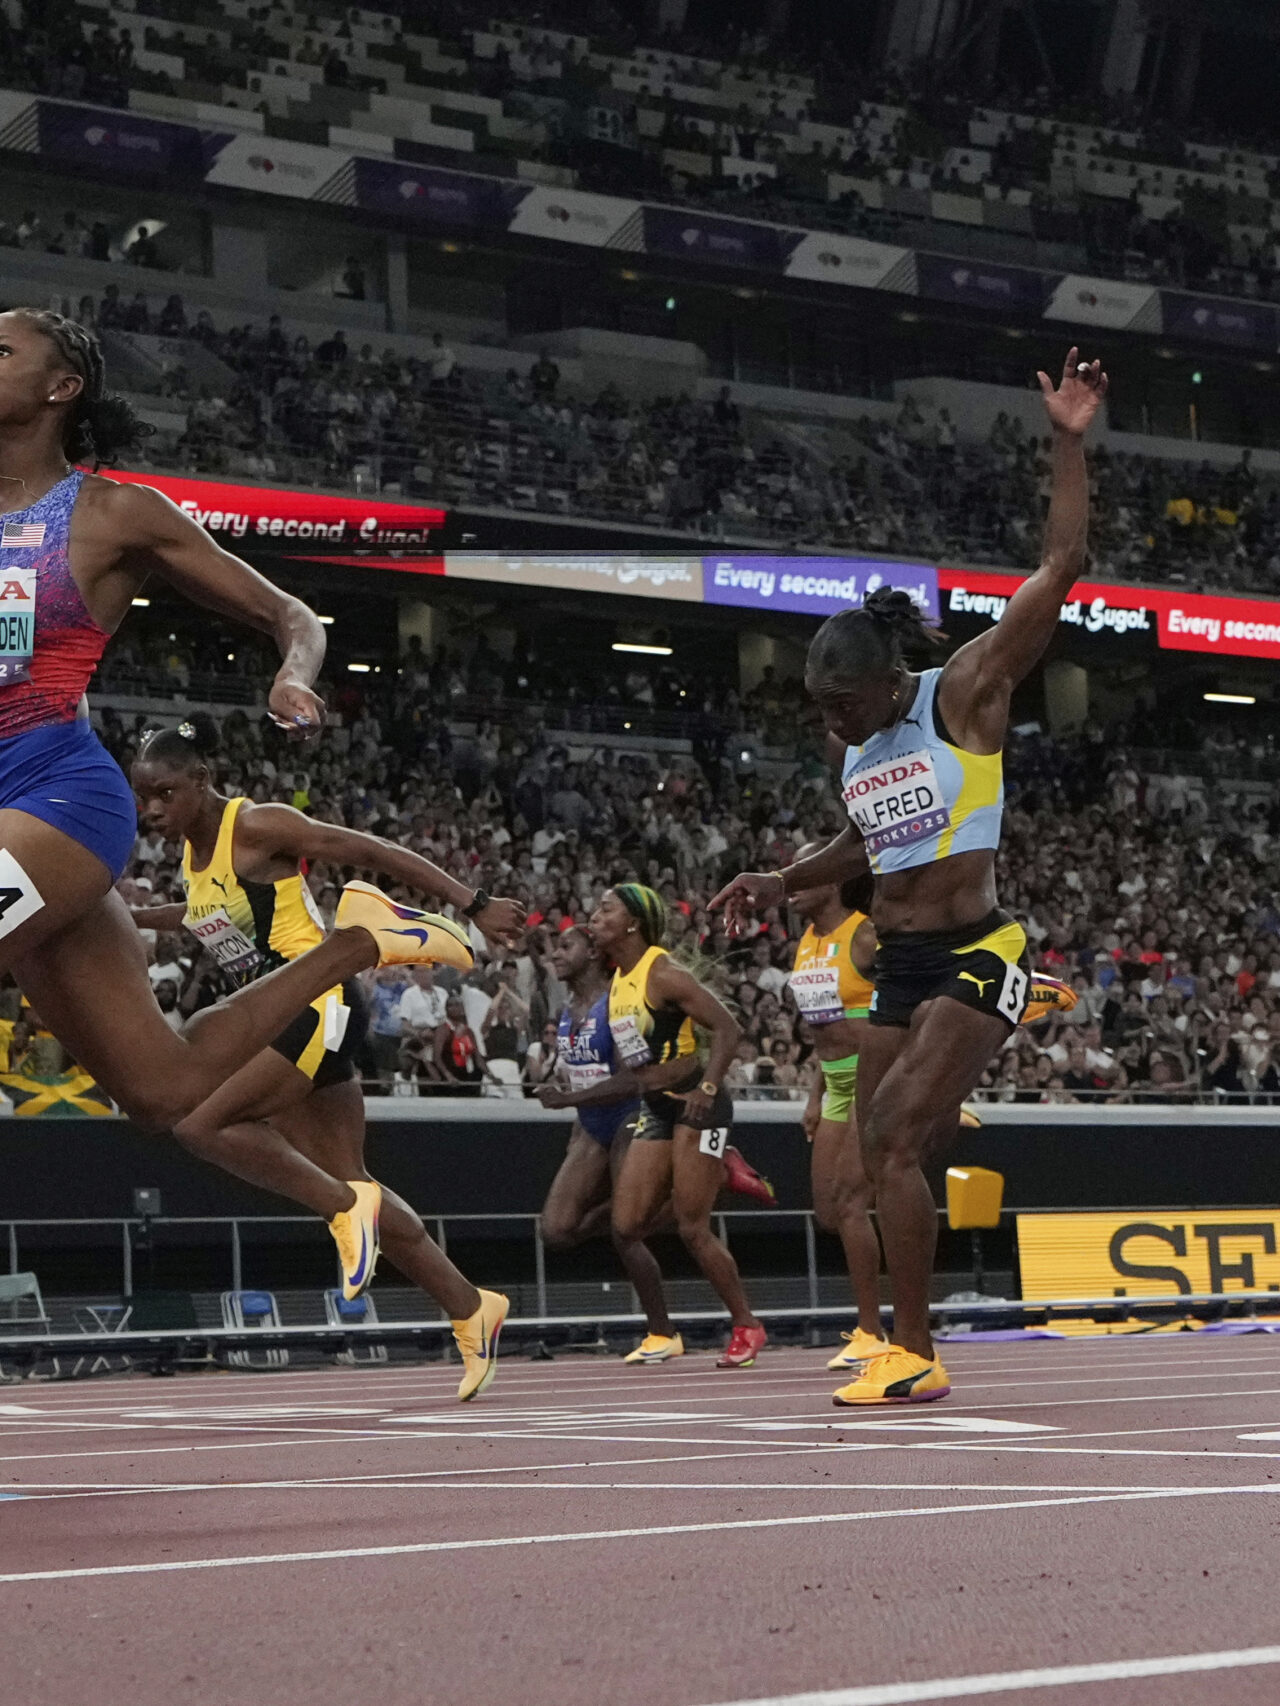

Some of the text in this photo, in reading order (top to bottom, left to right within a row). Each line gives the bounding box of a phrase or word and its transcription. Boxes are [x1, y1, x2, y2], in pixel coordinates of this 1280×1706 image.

[715, 562, 930, 606] Every second, Soi.
[949, 587, 1007, 621] Every
[1084, 598, 1149, 632] Sugoi.
[1168, 609, 1220, 642] Every
[844, 761, 930, 802] HONDA
[855, 786, 934, 832] ALFRED
[1007, 976, 1020, 1011] 5
[709, 1129, 720, 1151] 8
